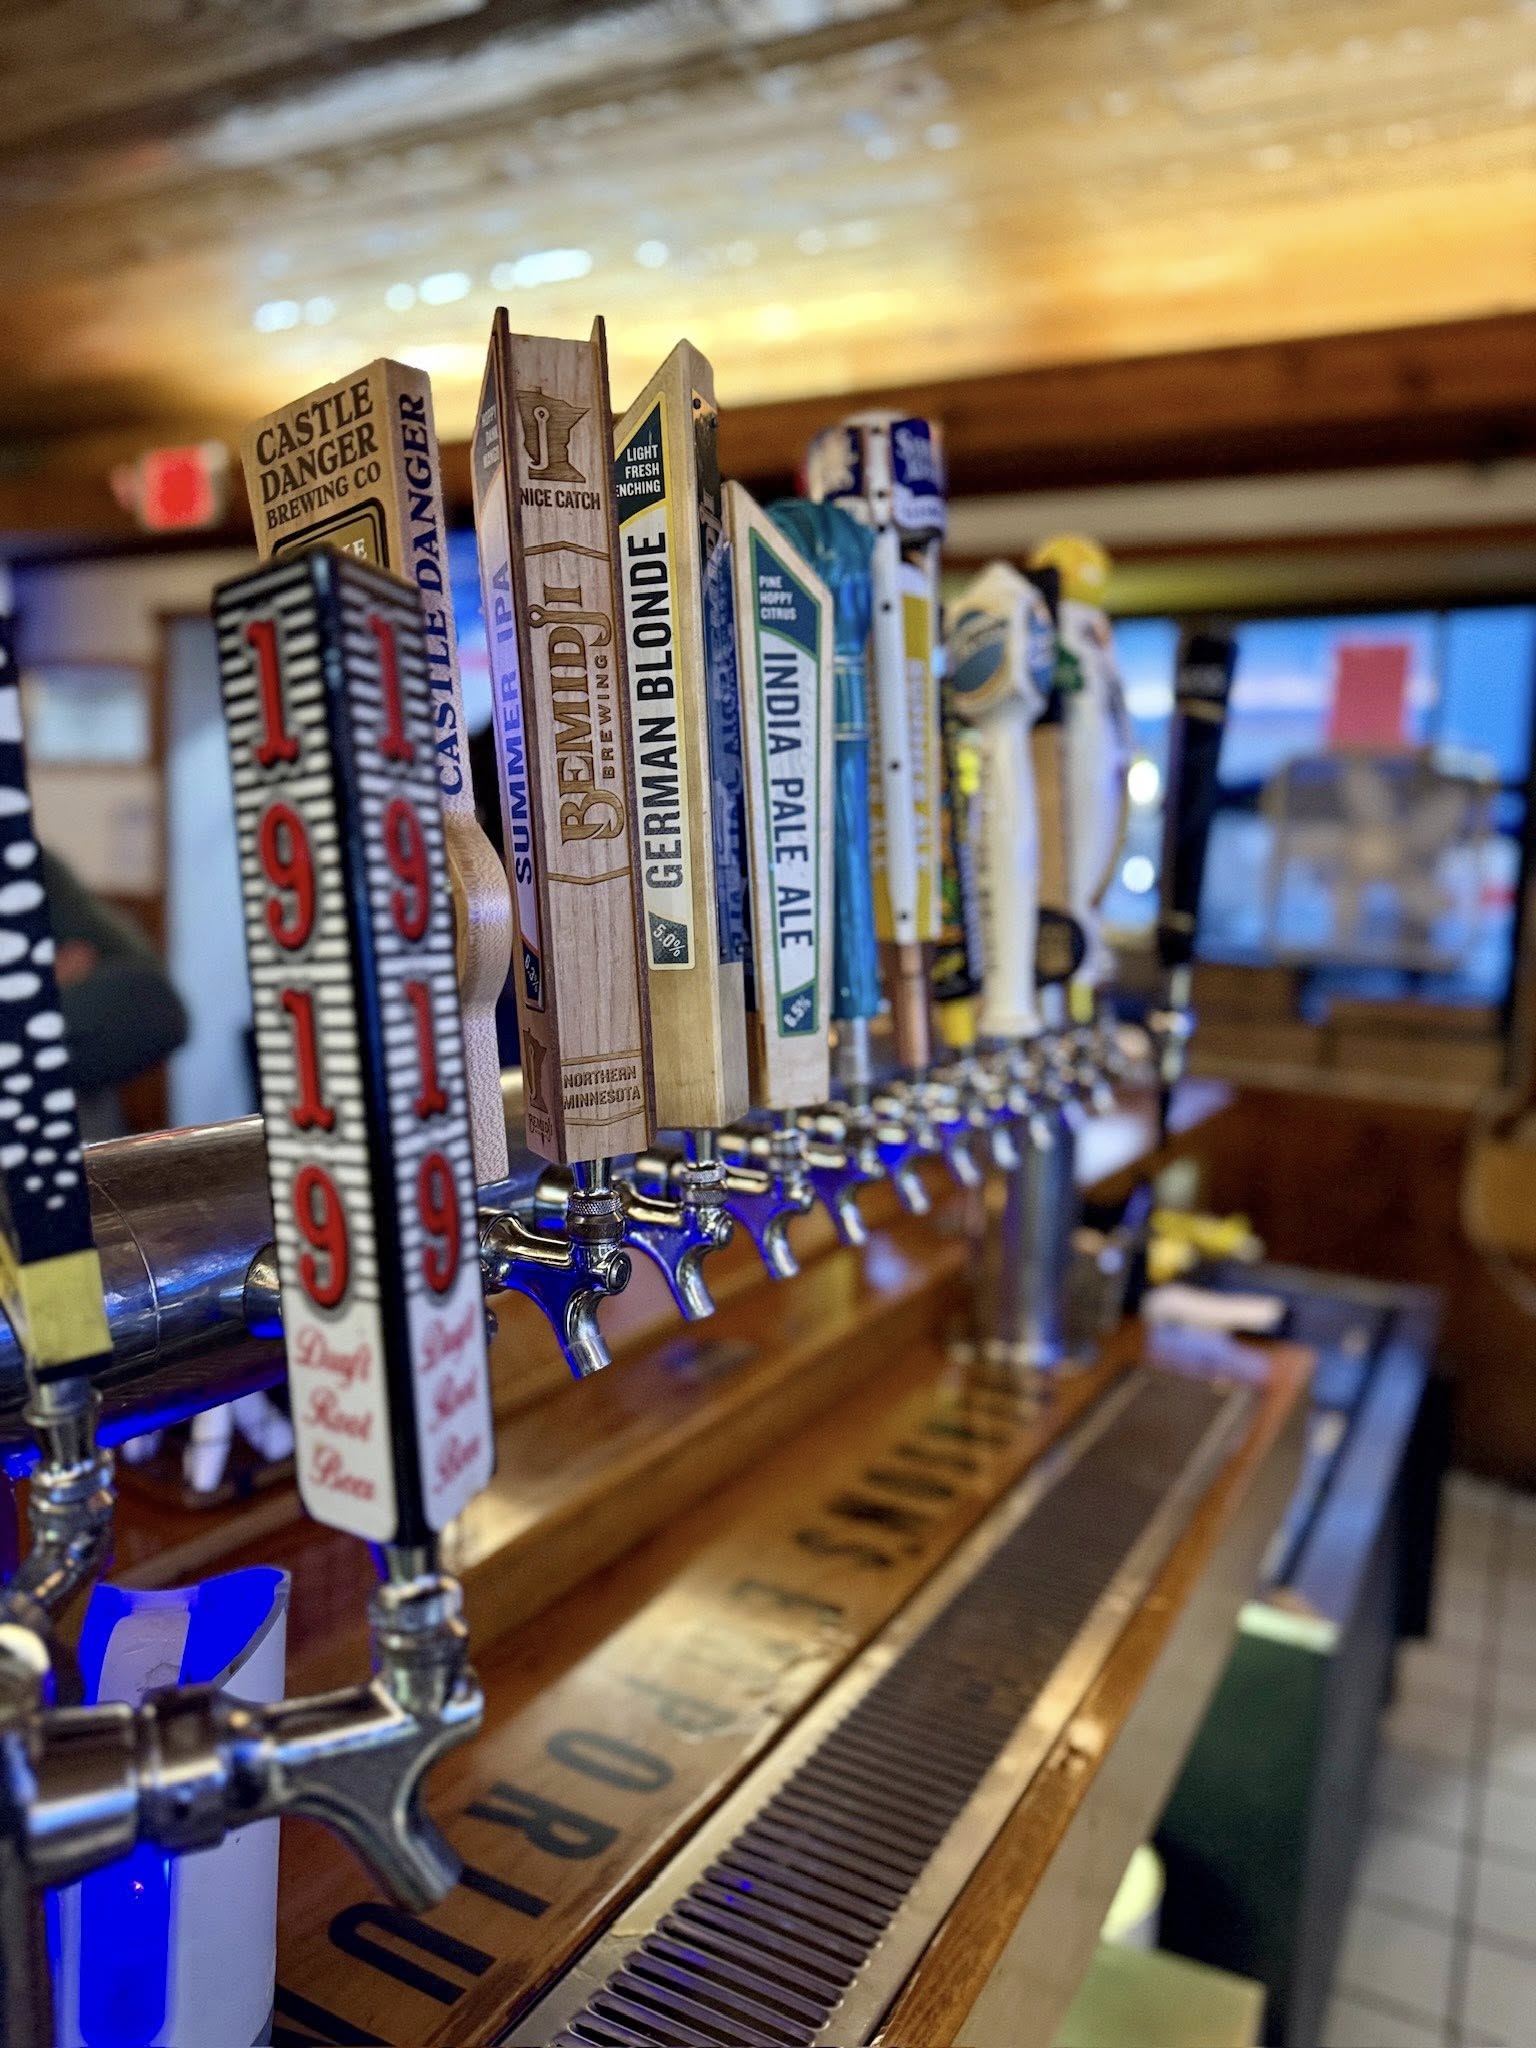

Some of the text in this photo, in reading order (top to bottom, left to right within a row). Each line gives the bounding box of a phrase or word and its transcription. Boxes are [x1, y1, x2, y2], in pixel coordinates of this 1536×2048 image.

[256, 378, 373, 466] CASTLE
[260, 422, 379, 504] DANGER
[626, 444, 659, 462] LIGHT
[266, 461, 381, 529] BREWING CO
[399, 393, 443, 595] DANGER
[520, 487, 601, 510] NICE CATCH
[625, 462, 660, 479] FRESH
[493, 561, 532, 885] SUMMER IPA
[529, 583, 624, 846] BEMIDJI
[592, 654, 615, 779] BREWING
[627, 531, 684, 890] GERMAN BLONDE
[763, 652, 813, 949] INDIA PALE ALE
[653, 923, 686, 957] 5.0%
[563, 1066, 637, 1089] NORTHERN
[563, 1085, 641, 1110] MINNESOTA
